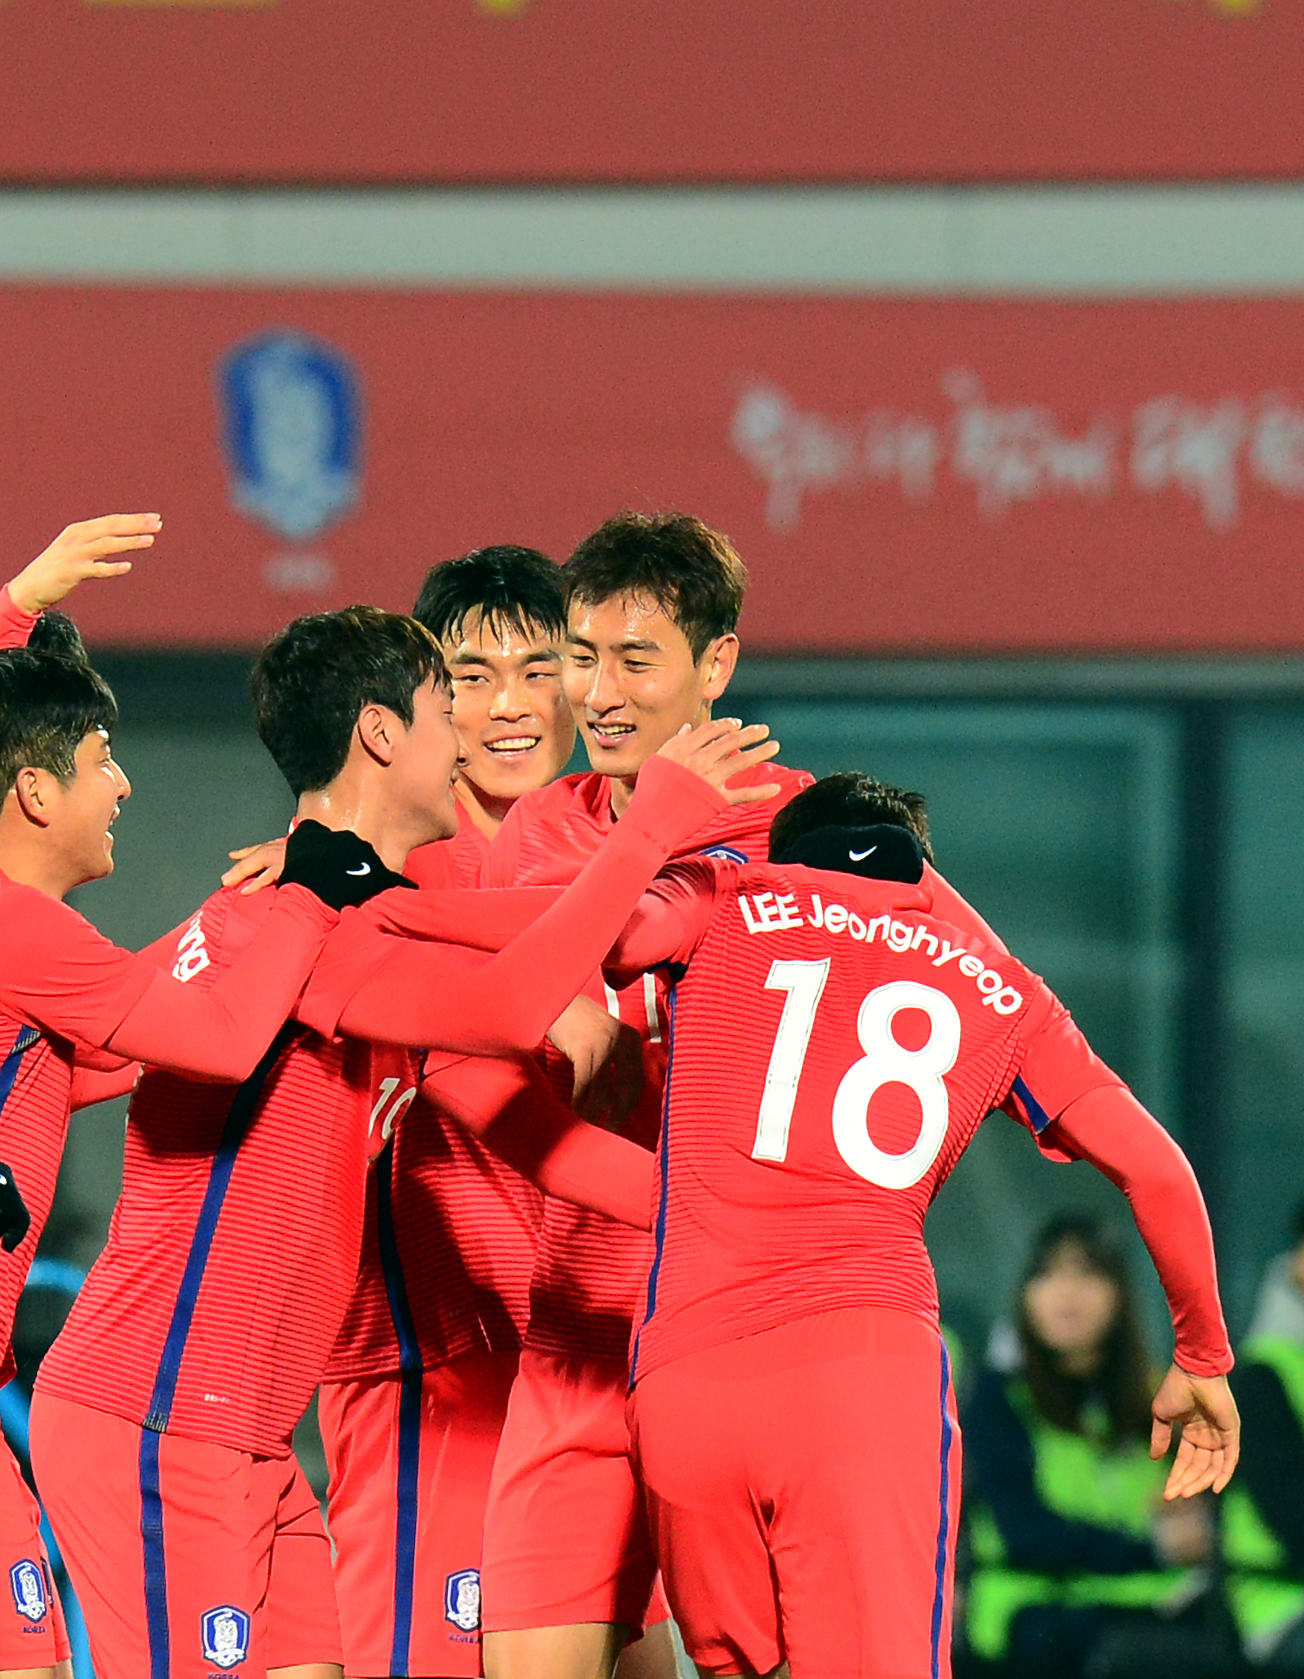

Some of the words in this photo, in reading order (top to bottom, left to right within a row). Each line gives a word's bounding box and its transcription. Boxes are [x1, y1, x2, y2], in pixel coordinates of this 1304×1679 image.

[738, 891, 804, 935] LEE
[807, 894, 1024, 1015] Jeonghyeop
[751, 957, 962, 1190] 18
